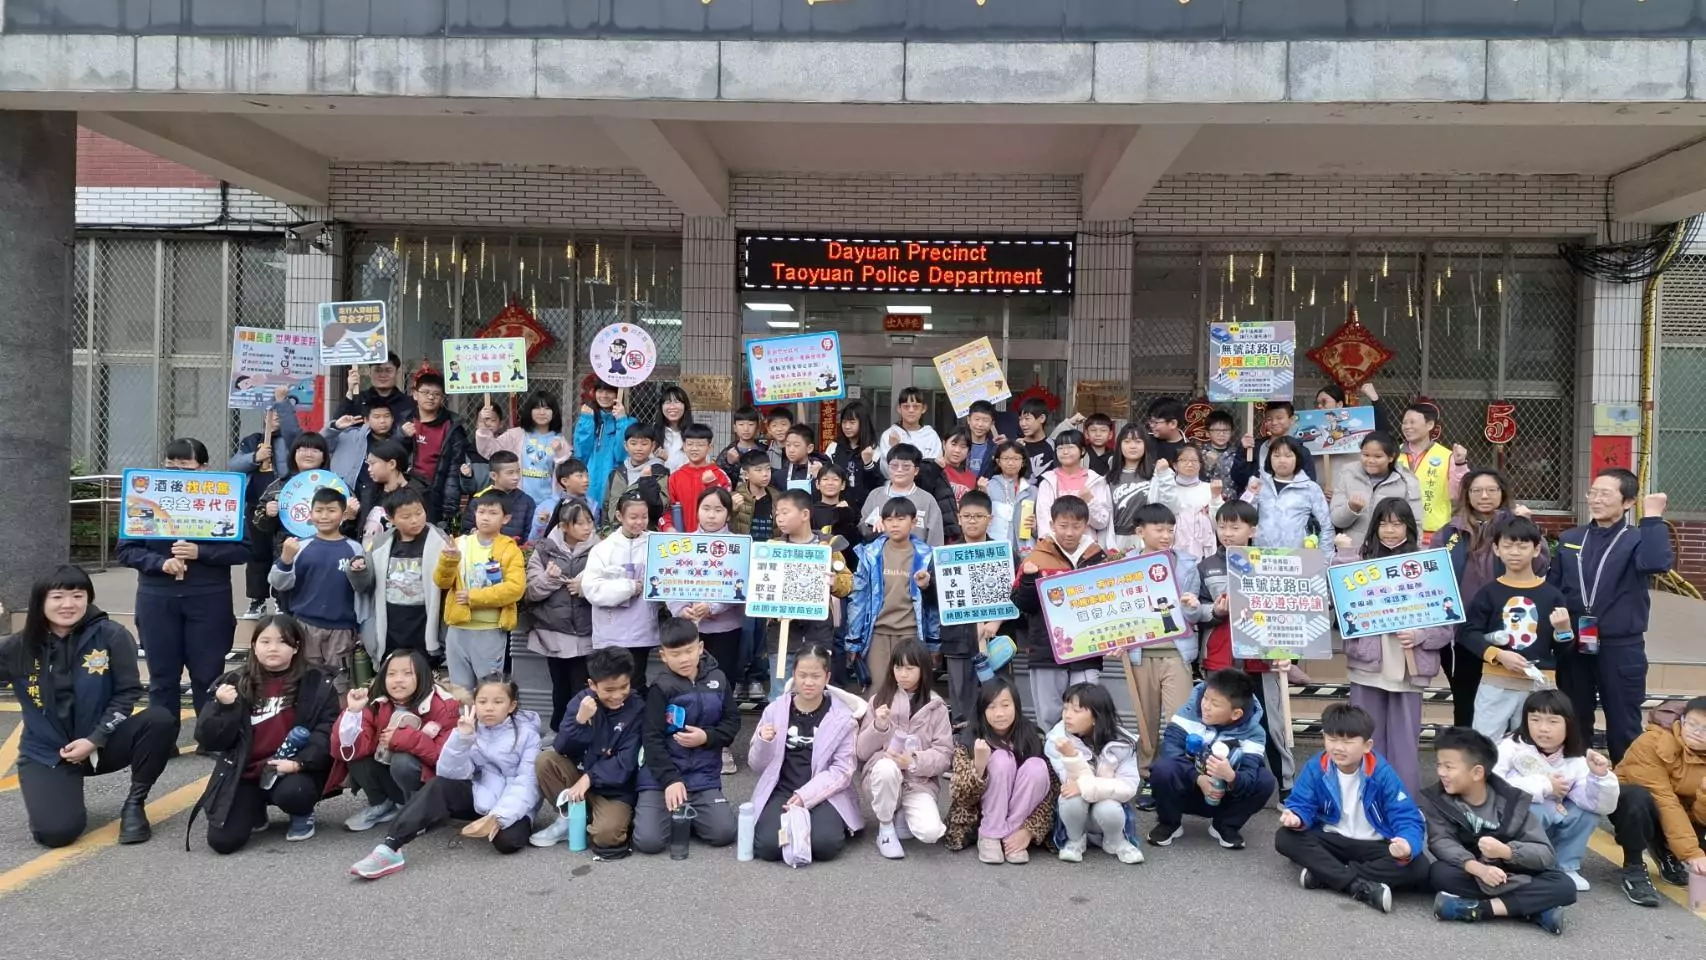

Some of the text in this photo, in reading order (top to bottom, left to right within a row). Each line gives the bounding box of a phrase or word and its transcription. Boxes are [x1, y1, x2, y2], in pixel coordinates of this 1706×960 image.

[829, 242, 987, 264] Dayuan Precinct
[771, 263, 1043, 286] Taoyuan Police Department
[1220, 343, 1281, 355] 無號誌路口
[1220, 355, 1292, 368] 停讓長者行人
[471, 371, 501, 384] 165
[1485, 403, 1517, 443] 5
[154, 479, 230, 495] 酒後找代駕
[159, 496, 237, 512] 安全零代價
[657, 537, 741, 559] 165 反詐騙
[772, 548, 825, 559] 反詐騙專區
[954, 546, 1007, 561] 反詐騙專區
[757, 562, 777, 571] 瀏覽
[942, 566, 963, 576] 瀏覽
[763, 573, 770, 581] &
[1343, 560, 1439, 591] 165 反詐騙
[755, 583, 776, 592] 歡迎
[950, 579, 958, 588] &
[1242, 577, 1311, 592] 無號誌路口
[755, 593, 775, 601] 下載
[945, 589, 965, 600] 歡迎
[752, 604, 823, 615] 桃園市警察局官網
[946, 599, 966, 608] 下載
[1250, 595, 1323, 611] 務必遵守停讓
[946, 606, 1014, 620] 桃園市警察局官網
